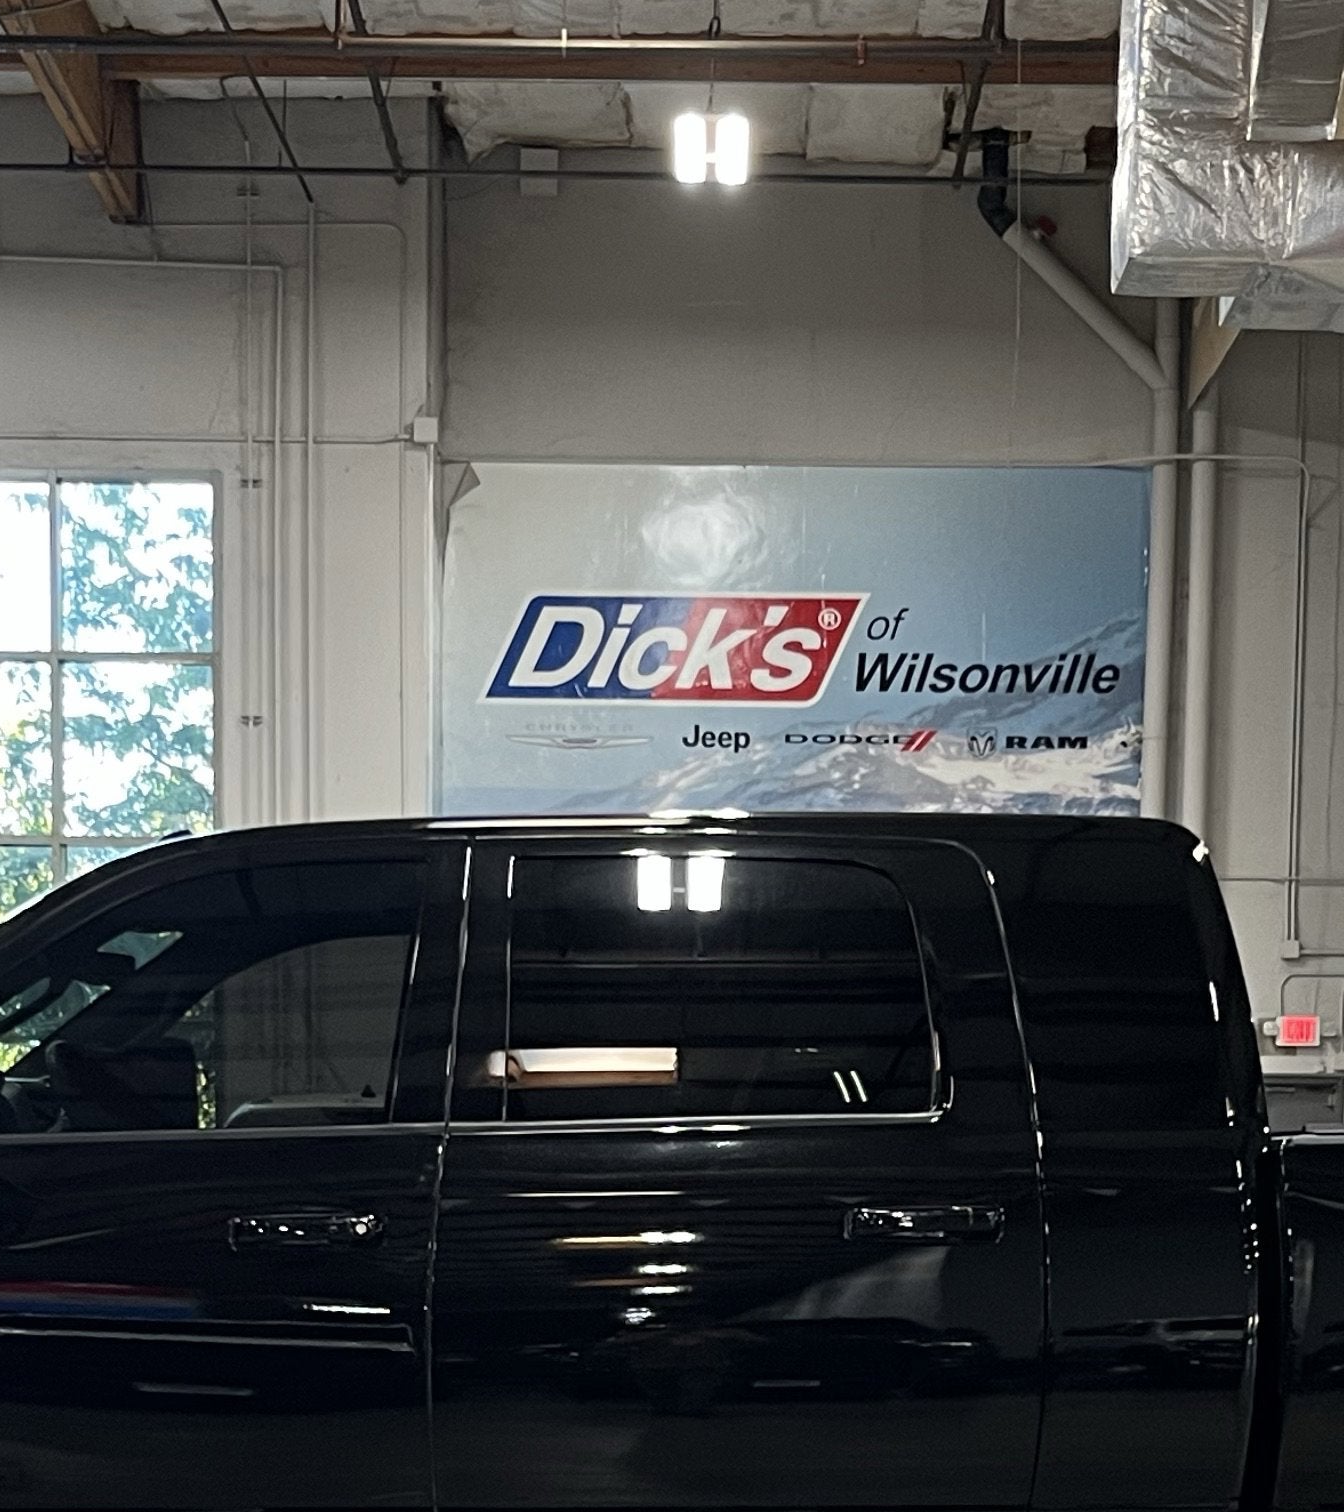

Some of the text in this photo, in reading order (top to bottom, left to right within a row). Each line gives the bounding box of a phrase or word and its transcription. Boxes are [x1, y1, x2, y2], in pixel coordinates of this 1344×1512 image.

[866, 608, 910, 641] of
[855, 653, 1122, 694] Wilsonville
[682, 725, 751, 752] Jeep
[1006, 736, 1088, 749] RAM
